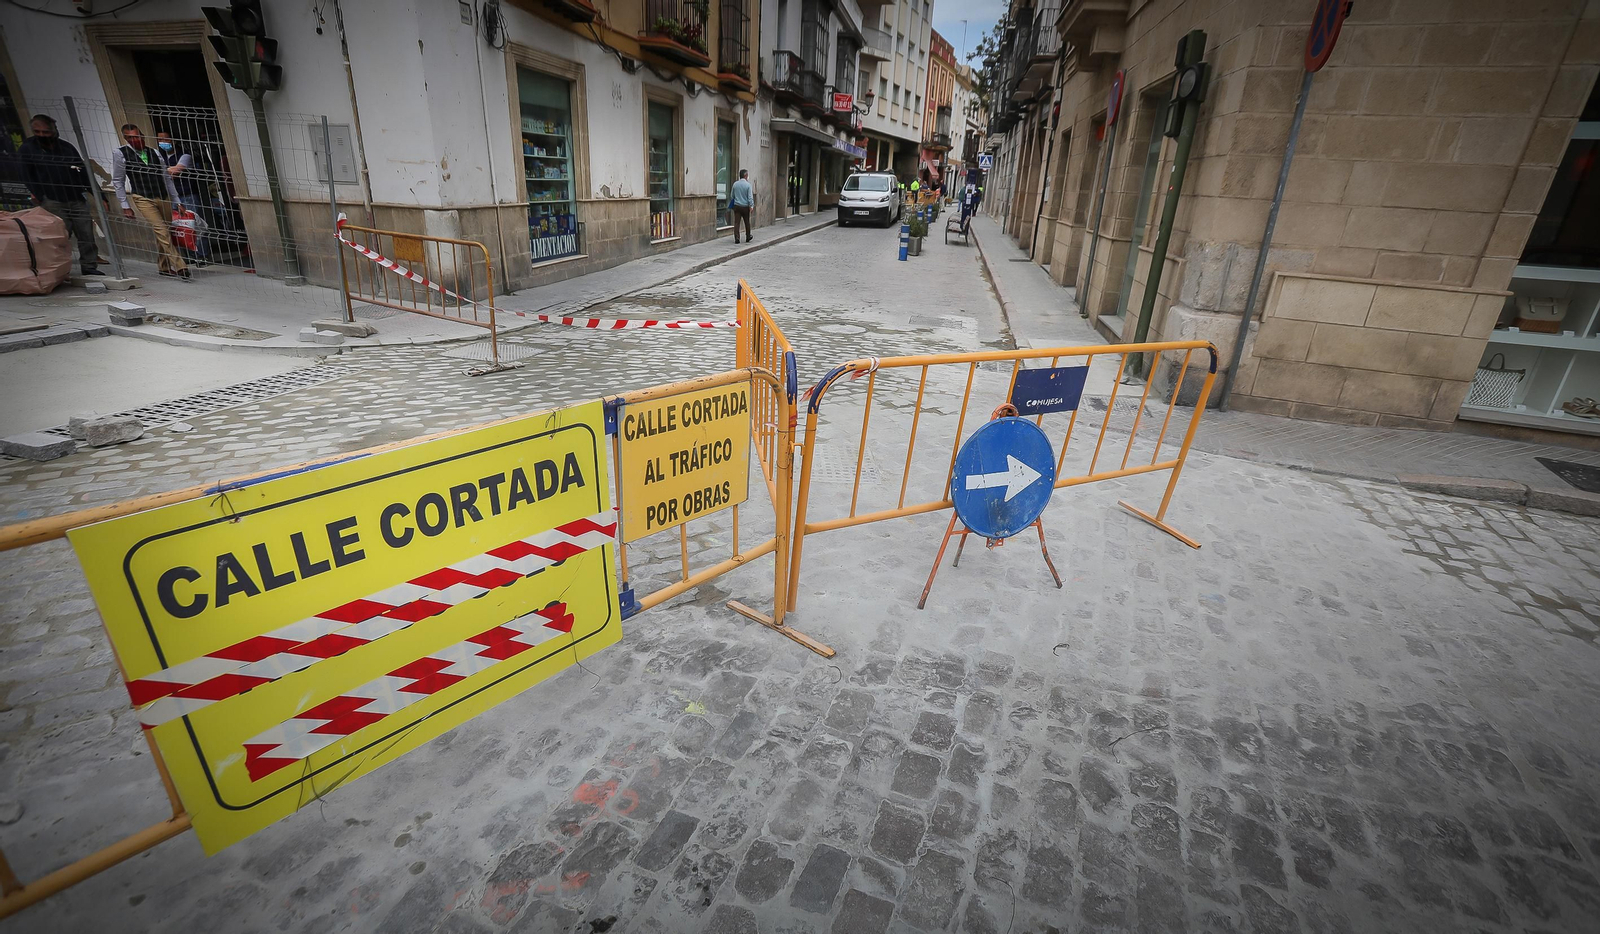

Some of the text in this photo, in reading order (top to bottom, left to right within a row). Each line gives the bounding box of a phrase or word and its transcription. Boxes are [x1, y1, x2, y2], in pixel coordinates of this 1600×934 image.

[530, 230, 577, 260] LIMENTACIÓN
[624, 390, 748, 442] CALLE CORTADA
[644, 438, 732, 485] AL TRÁFICO
[646, 480, 731, 530] POR OBRAS
[156, 451, 586, 619] CALLE CORTADA
